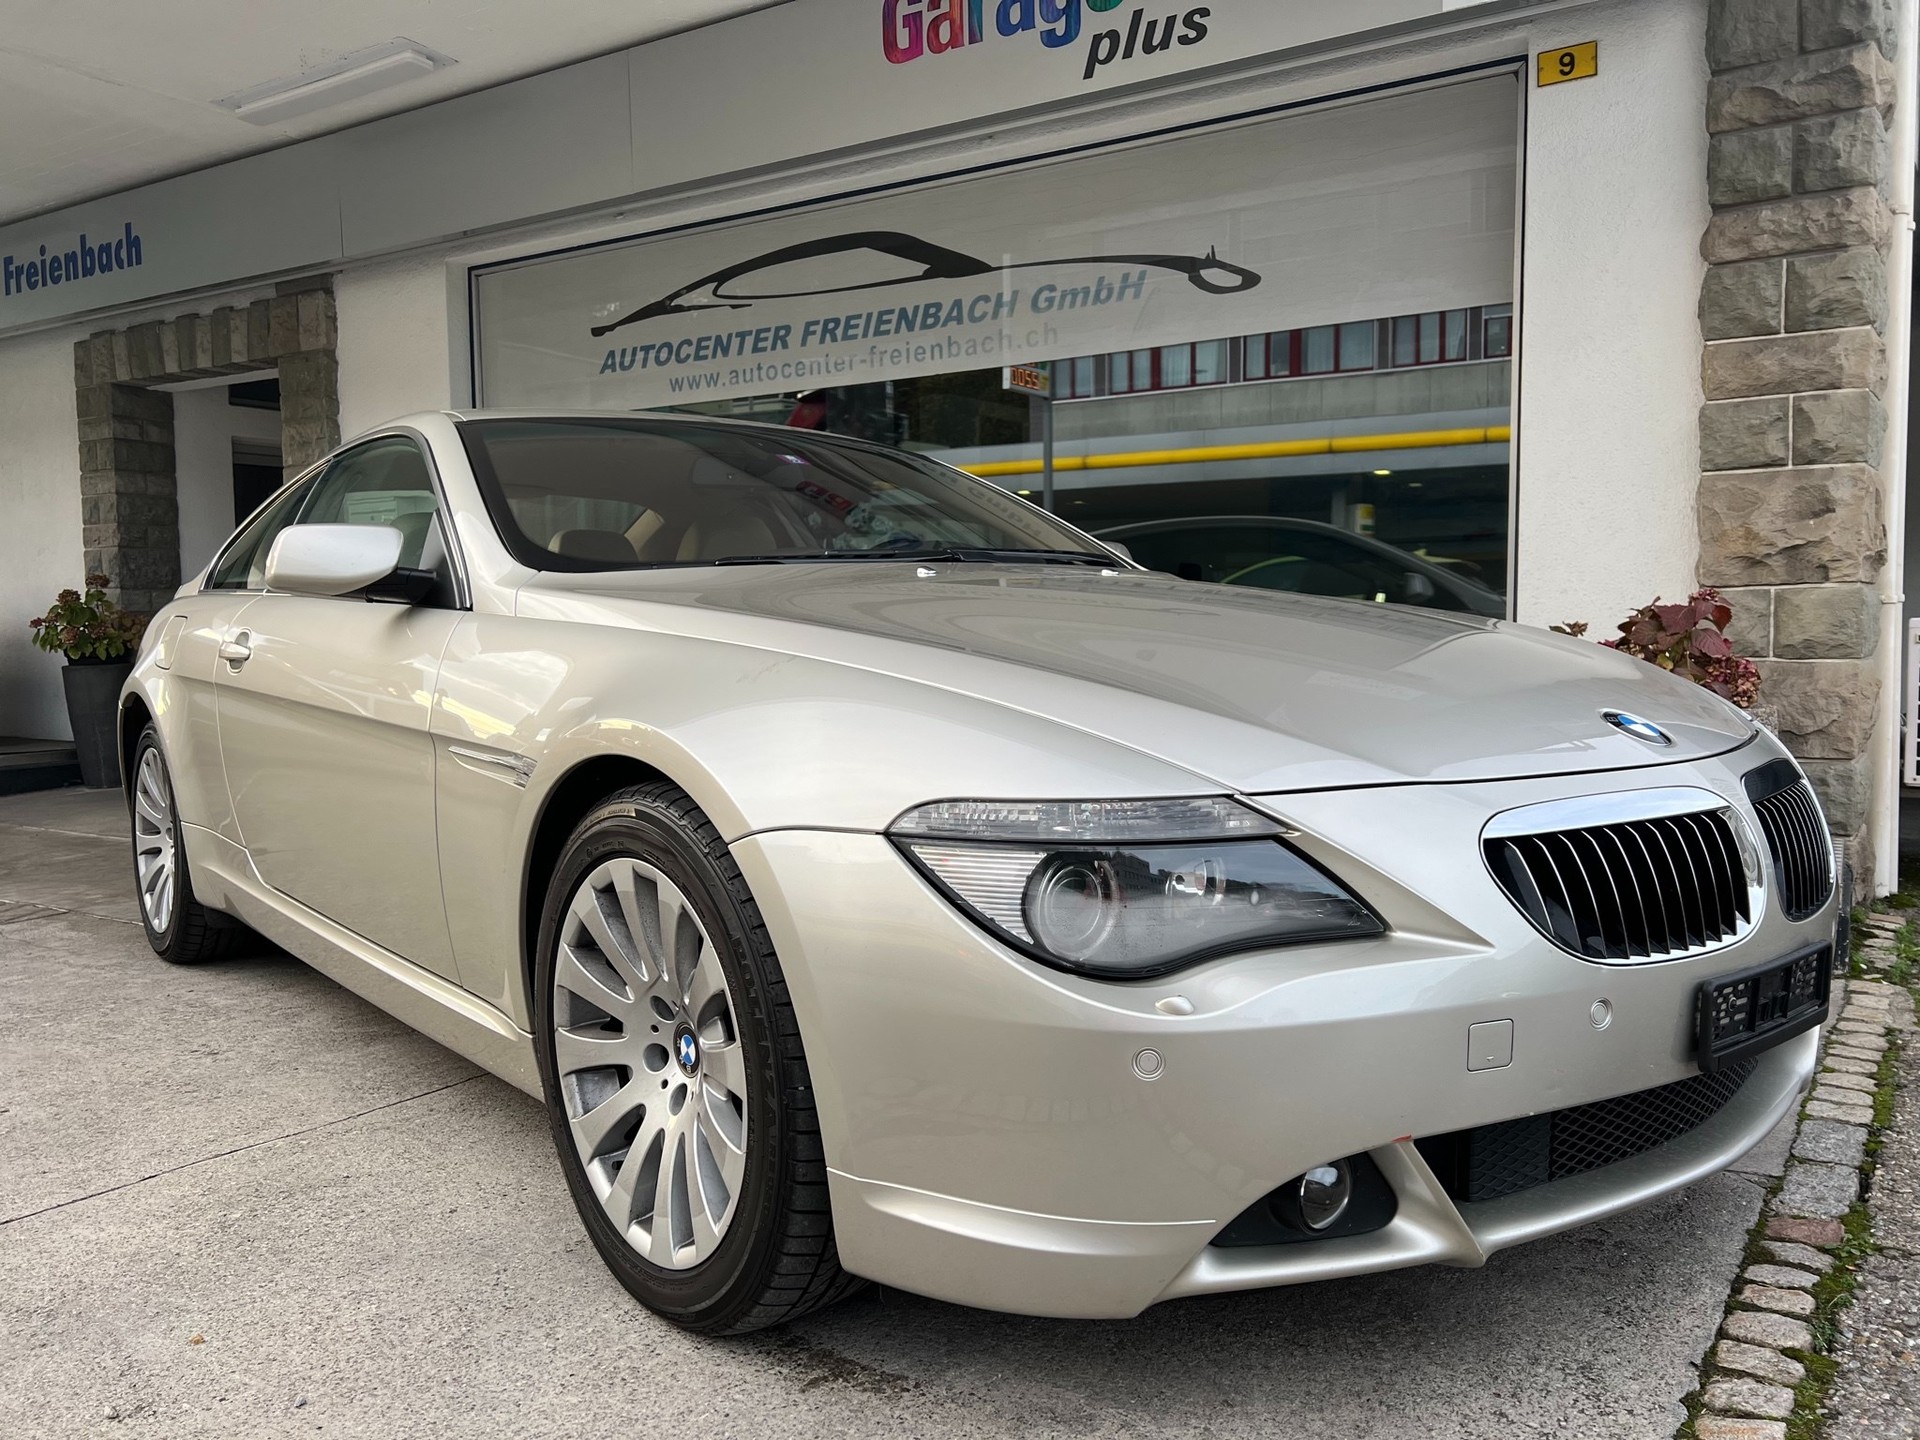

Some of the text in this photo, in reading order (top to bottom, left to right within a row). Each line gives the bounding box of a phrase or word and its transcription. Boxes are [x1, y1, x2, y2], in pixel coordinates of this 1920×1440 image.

[882, 0, 1126, 64] Garag
[1083, 7, 1211, 80] plus
[1559, 52, 1576, 76] 9
[3, 222, 142, 296] Freienbach
[600, 270, 1148, 375] AUTOCENTER FREIENBACH GmbH
[669, 322, 1058, 393] www.autocenter-freienbach.ch
